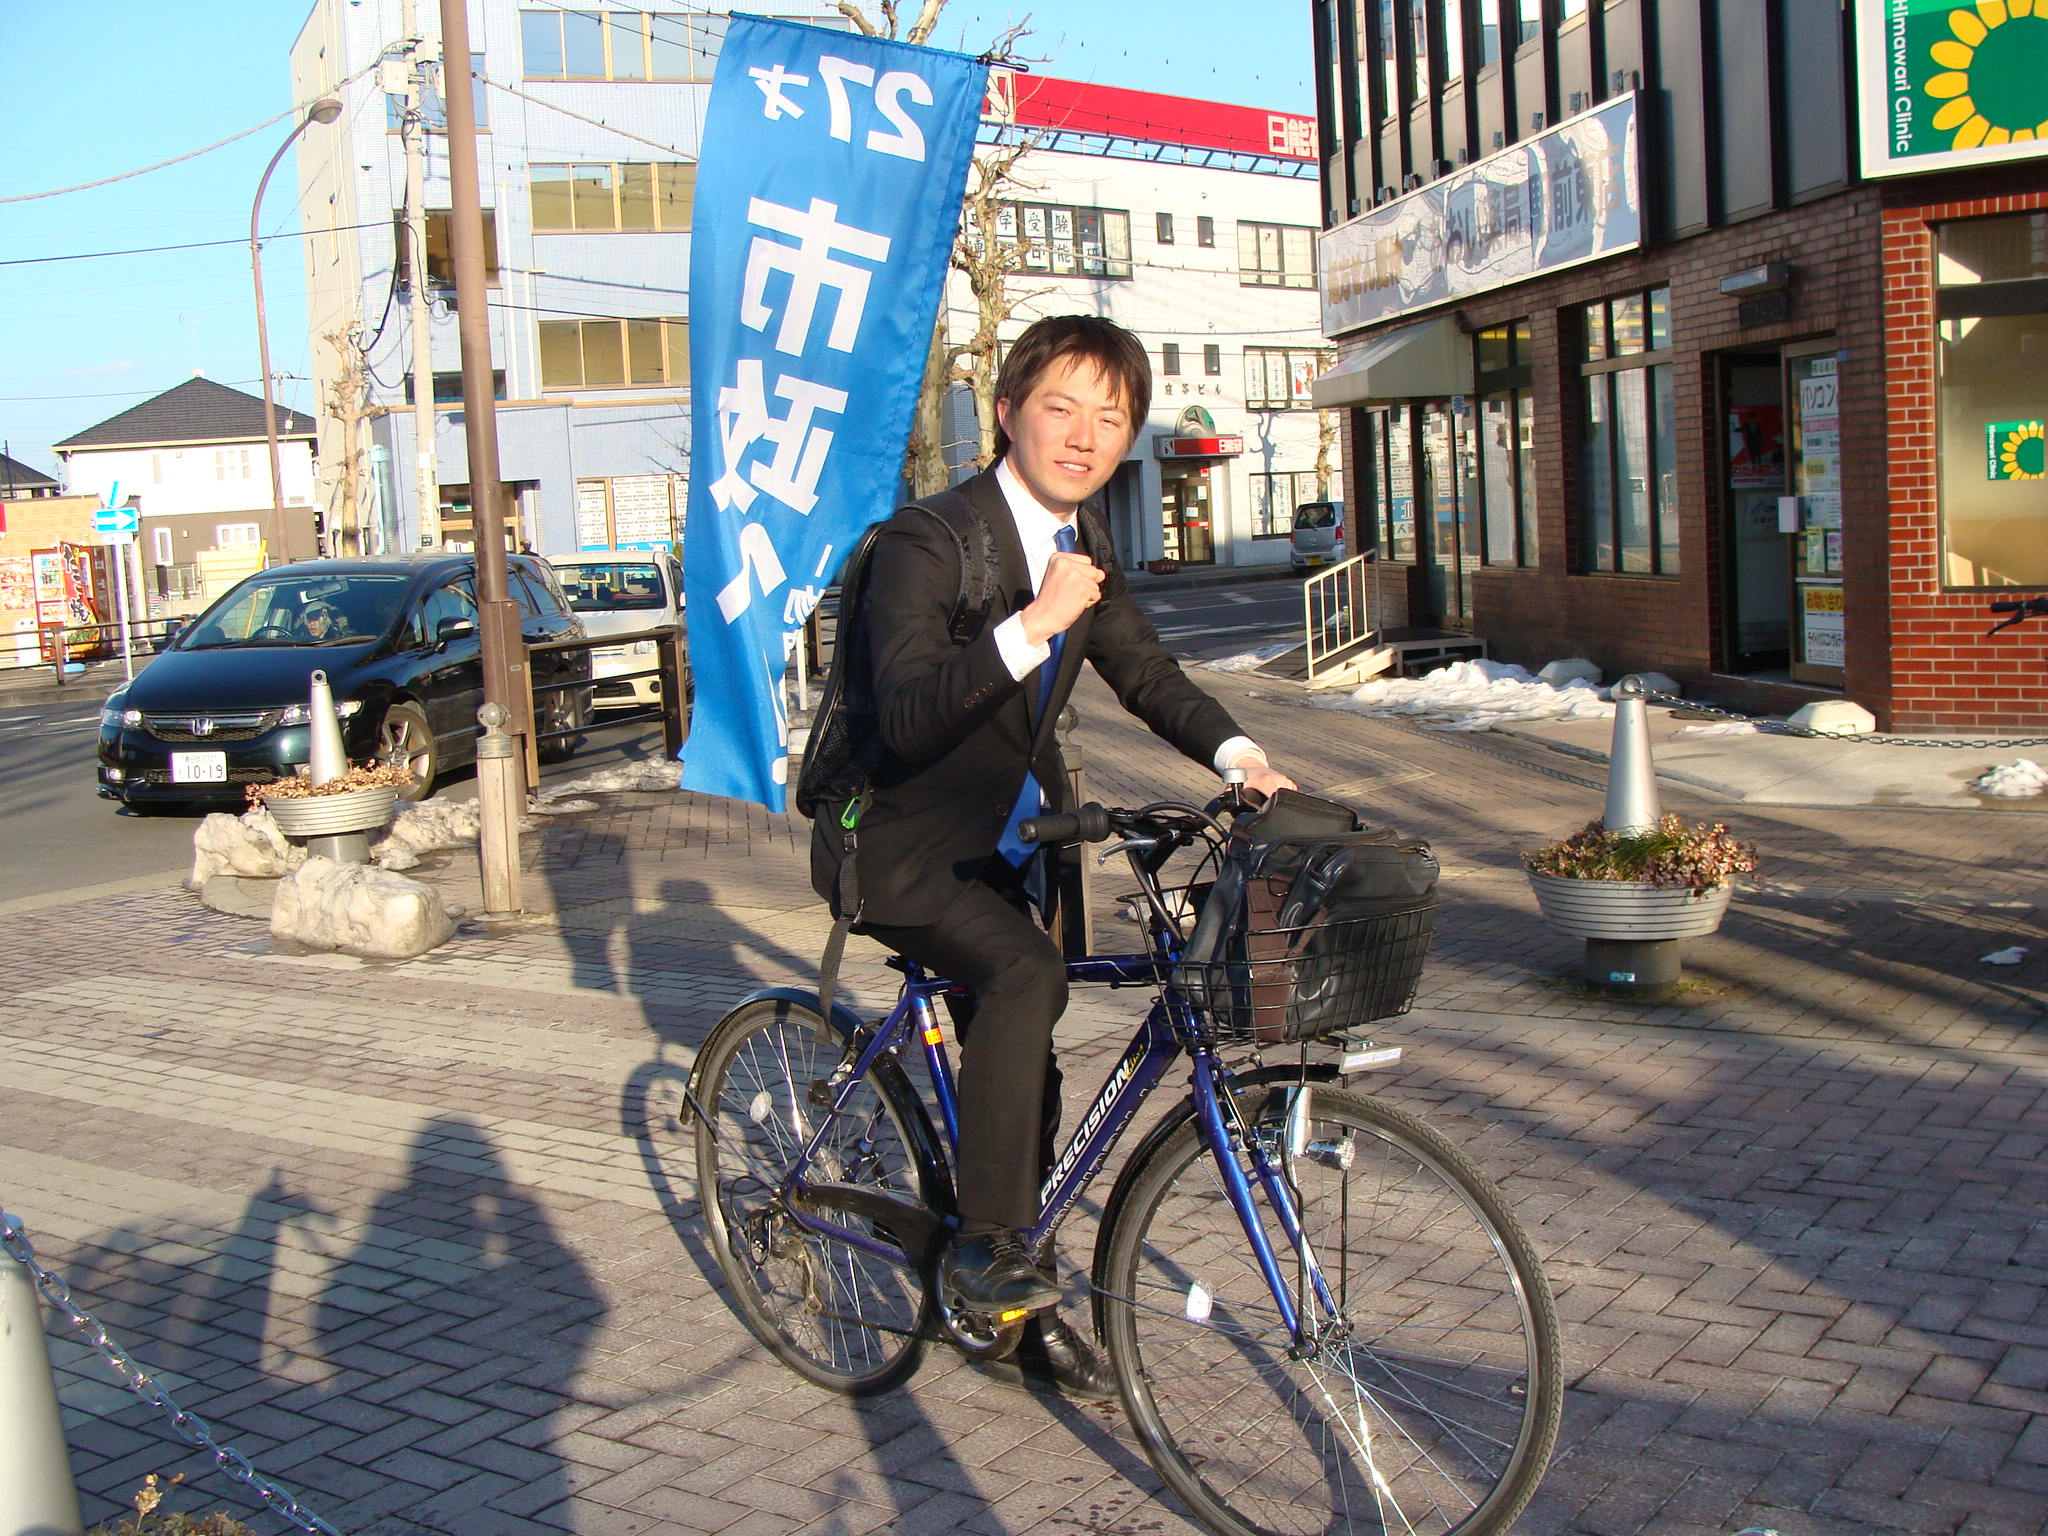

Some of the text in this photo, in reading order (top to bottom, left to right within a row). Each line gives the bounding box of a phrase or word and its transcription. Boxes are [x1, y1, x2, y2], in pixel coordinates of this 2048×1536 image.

[1892, 0, 1913, 153] Himawari Clinic
[187, 764, 223, 779] 10-19
[1040, 1058, 1130, 1207] PRECISION
